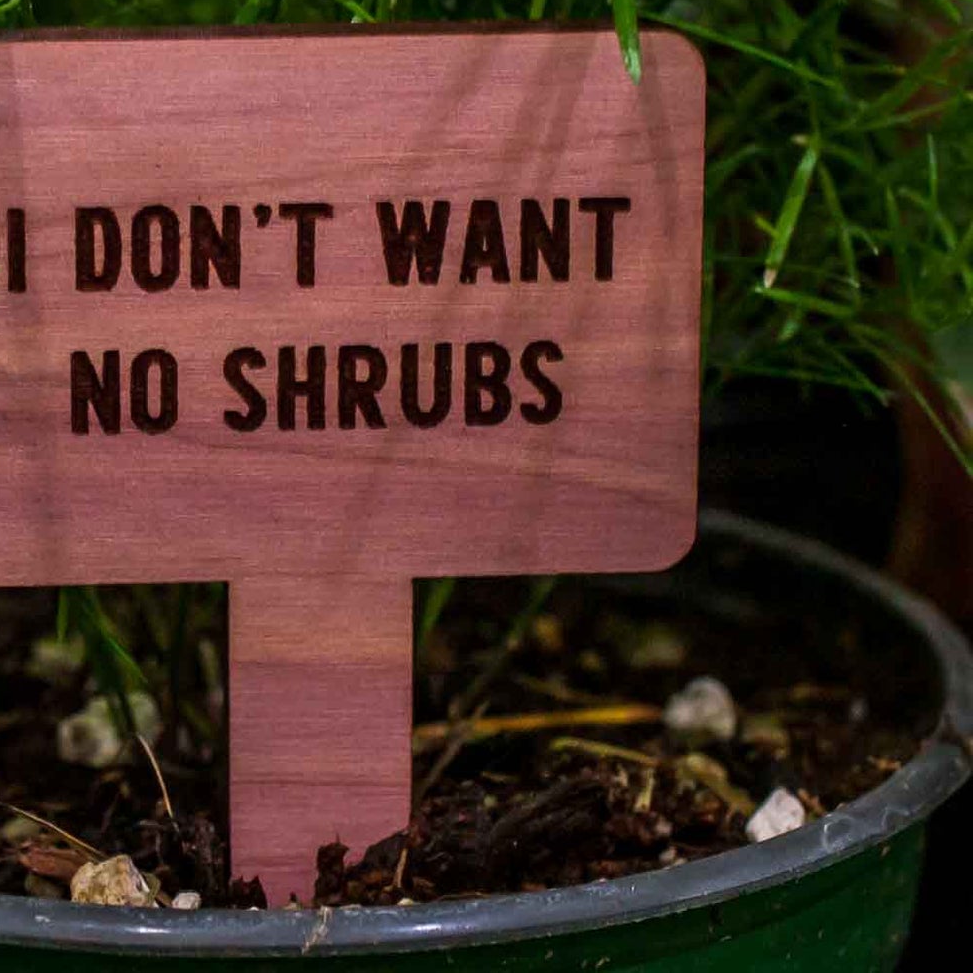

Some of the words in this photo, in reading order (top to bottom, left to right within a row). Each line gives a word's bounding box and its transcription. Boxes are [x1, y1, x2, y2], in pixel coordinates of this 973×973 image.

[5, 207, 27, 294] I
[74, 202, 335, 293] DON'T
[375, 195, 632, 287] WANT
[70, 348, 179, 436] NO
[223, 339, 565, 433] SHRUBS
